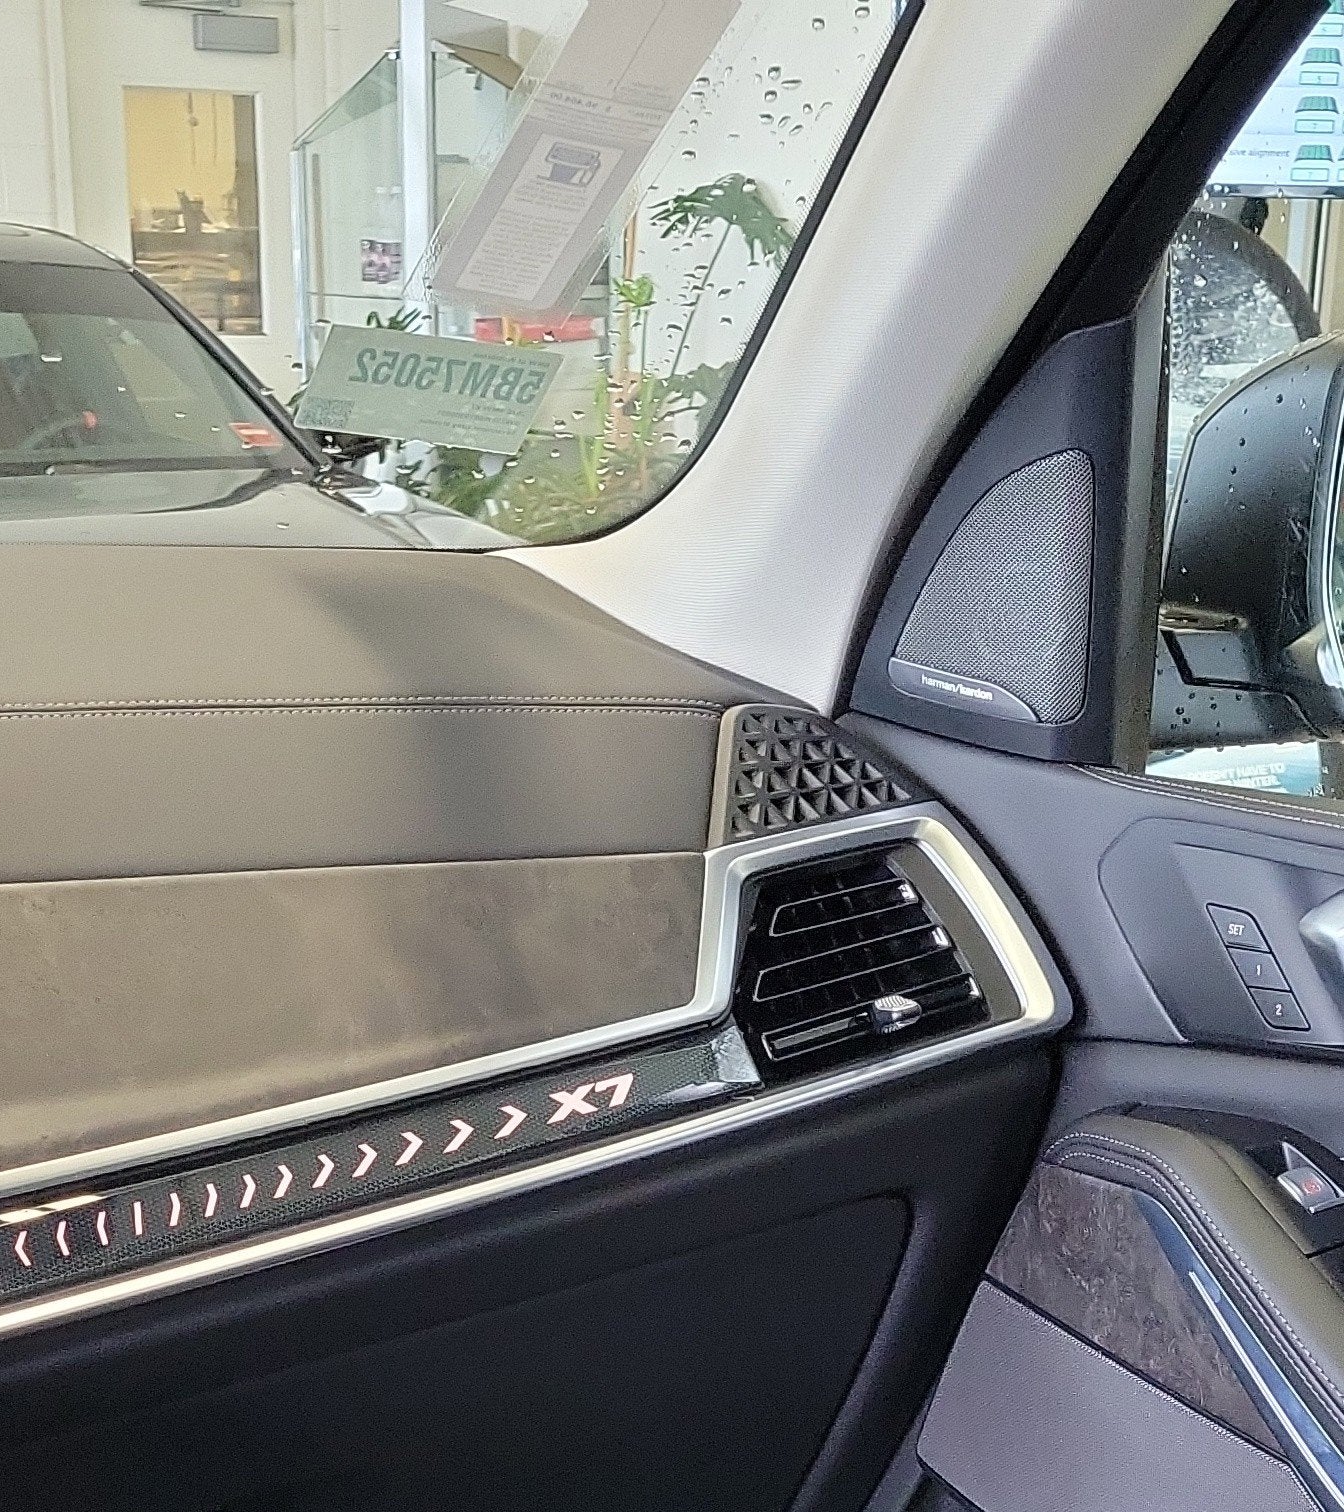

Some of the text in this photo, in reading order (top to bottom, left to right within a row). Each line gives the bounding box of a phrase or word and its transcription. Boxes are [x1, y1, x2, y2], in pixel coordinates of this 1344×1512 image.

[921, 673, 994, 702] harman/kardon
[1227, 923, 1245, 936] SET
[1256, 964, 1261, 976] 1
[1275, 1003, 1282, 1016] 2
[546, 1072, 634, 1125] X7
